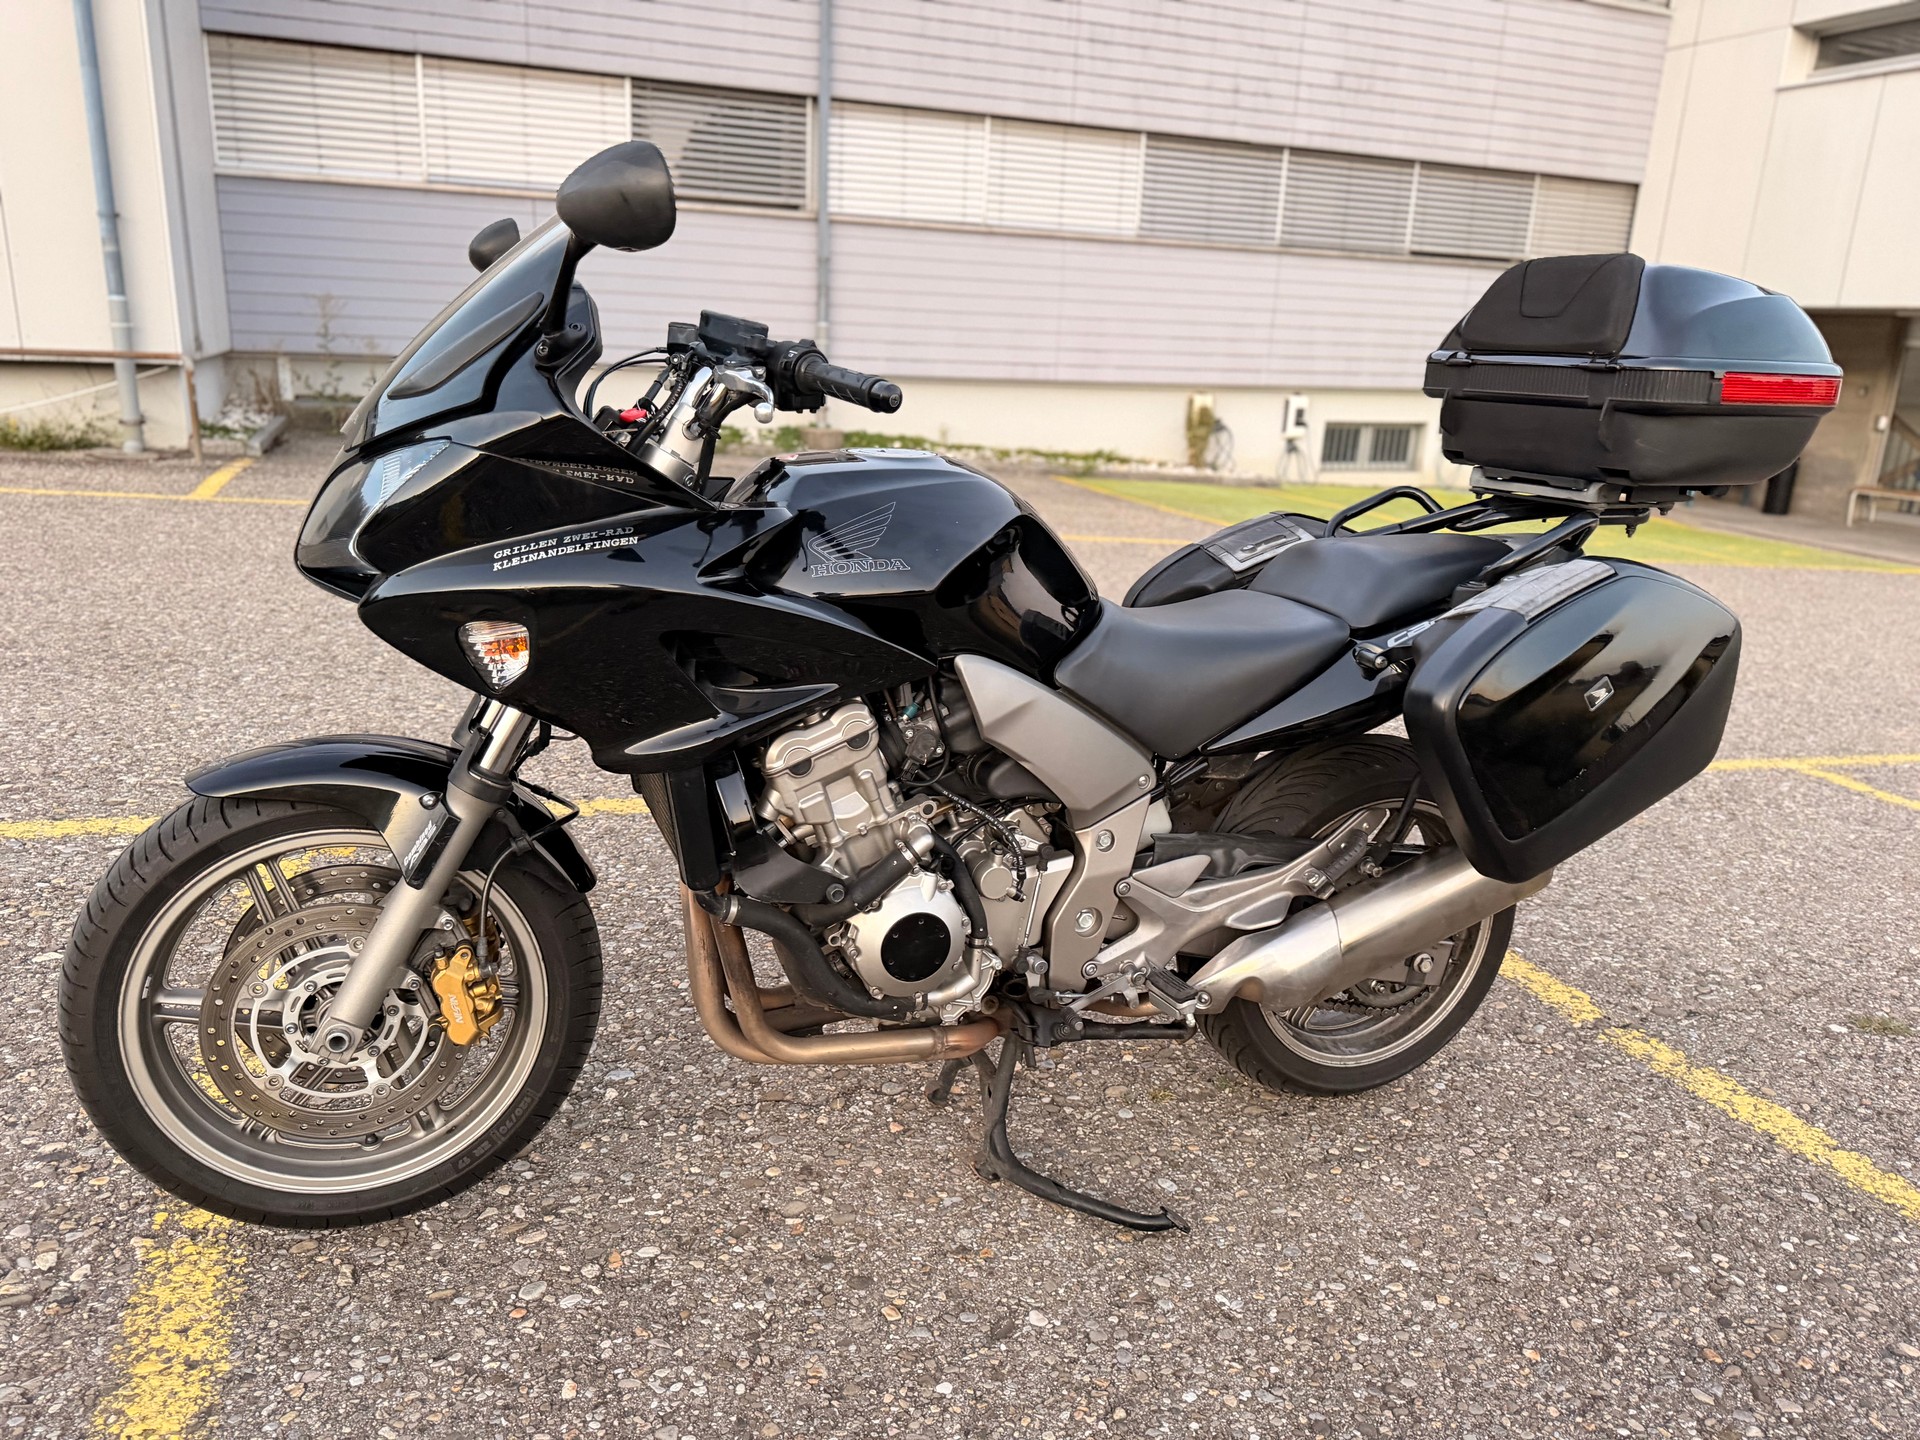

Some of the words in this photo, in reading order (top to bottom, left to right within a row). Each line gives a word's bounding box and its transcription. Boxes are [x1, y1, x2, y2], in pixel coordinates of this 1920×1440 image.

[492, 536, 639, 572] KLEINANDELFINGEN
[493, 538, 558, 559] GRILLEN
[563, 526, 635, 544] ZWEI-RAD
[811, 559, 911, 577] HONDA
